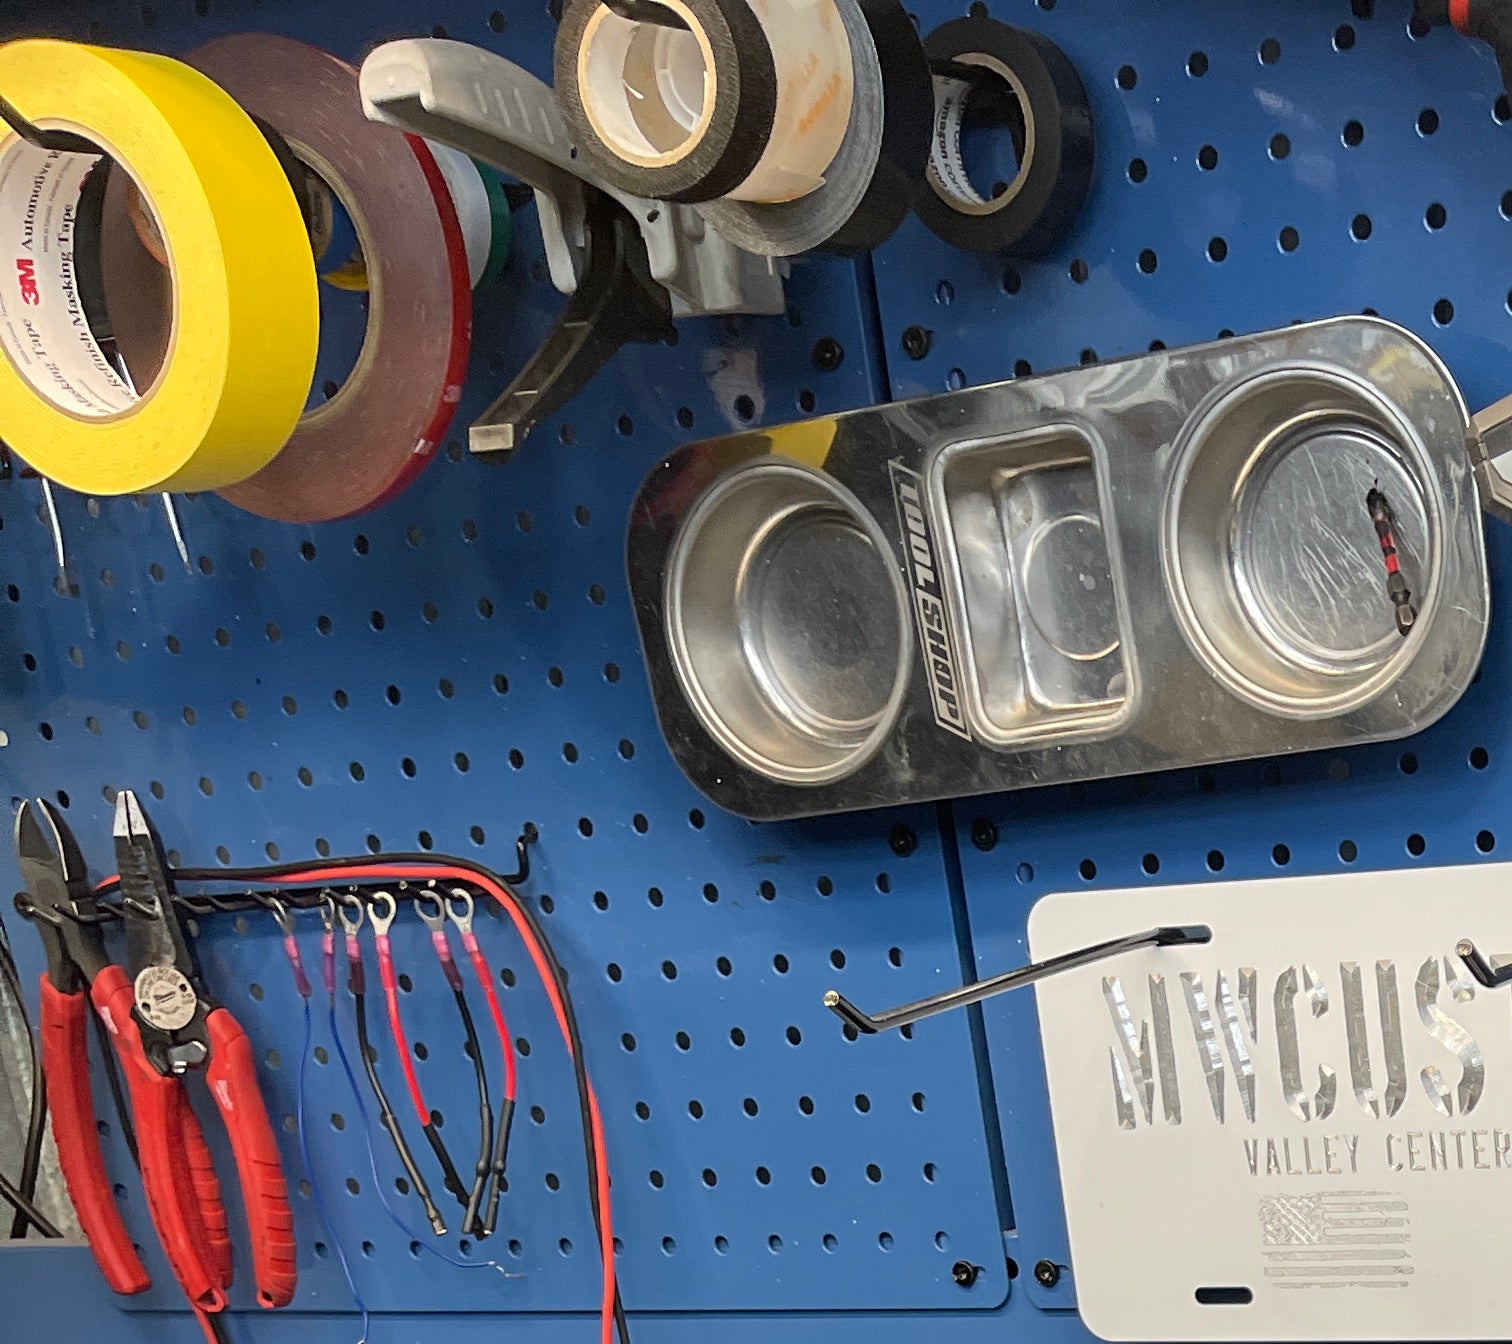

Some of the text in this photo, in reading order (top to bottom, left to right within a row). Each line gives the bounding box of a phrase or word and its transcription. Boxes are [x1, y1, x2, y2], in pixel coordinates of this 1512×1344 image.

[20, 162, 51, 251] Automotive
[57, 203, 74, 248] Tape
[16, 258, 40, 306] 3M
[58, 251, 89, 328] Masking
[23, 318, 48, 360] Tape
[80, 331, 122, 387] Refinish
[900, 481, 960, 723] TOOL SHOP
[1242, 1134, 1360, 1177] VALLEY
[1386, 1127, 1512, 1172] CENTER
